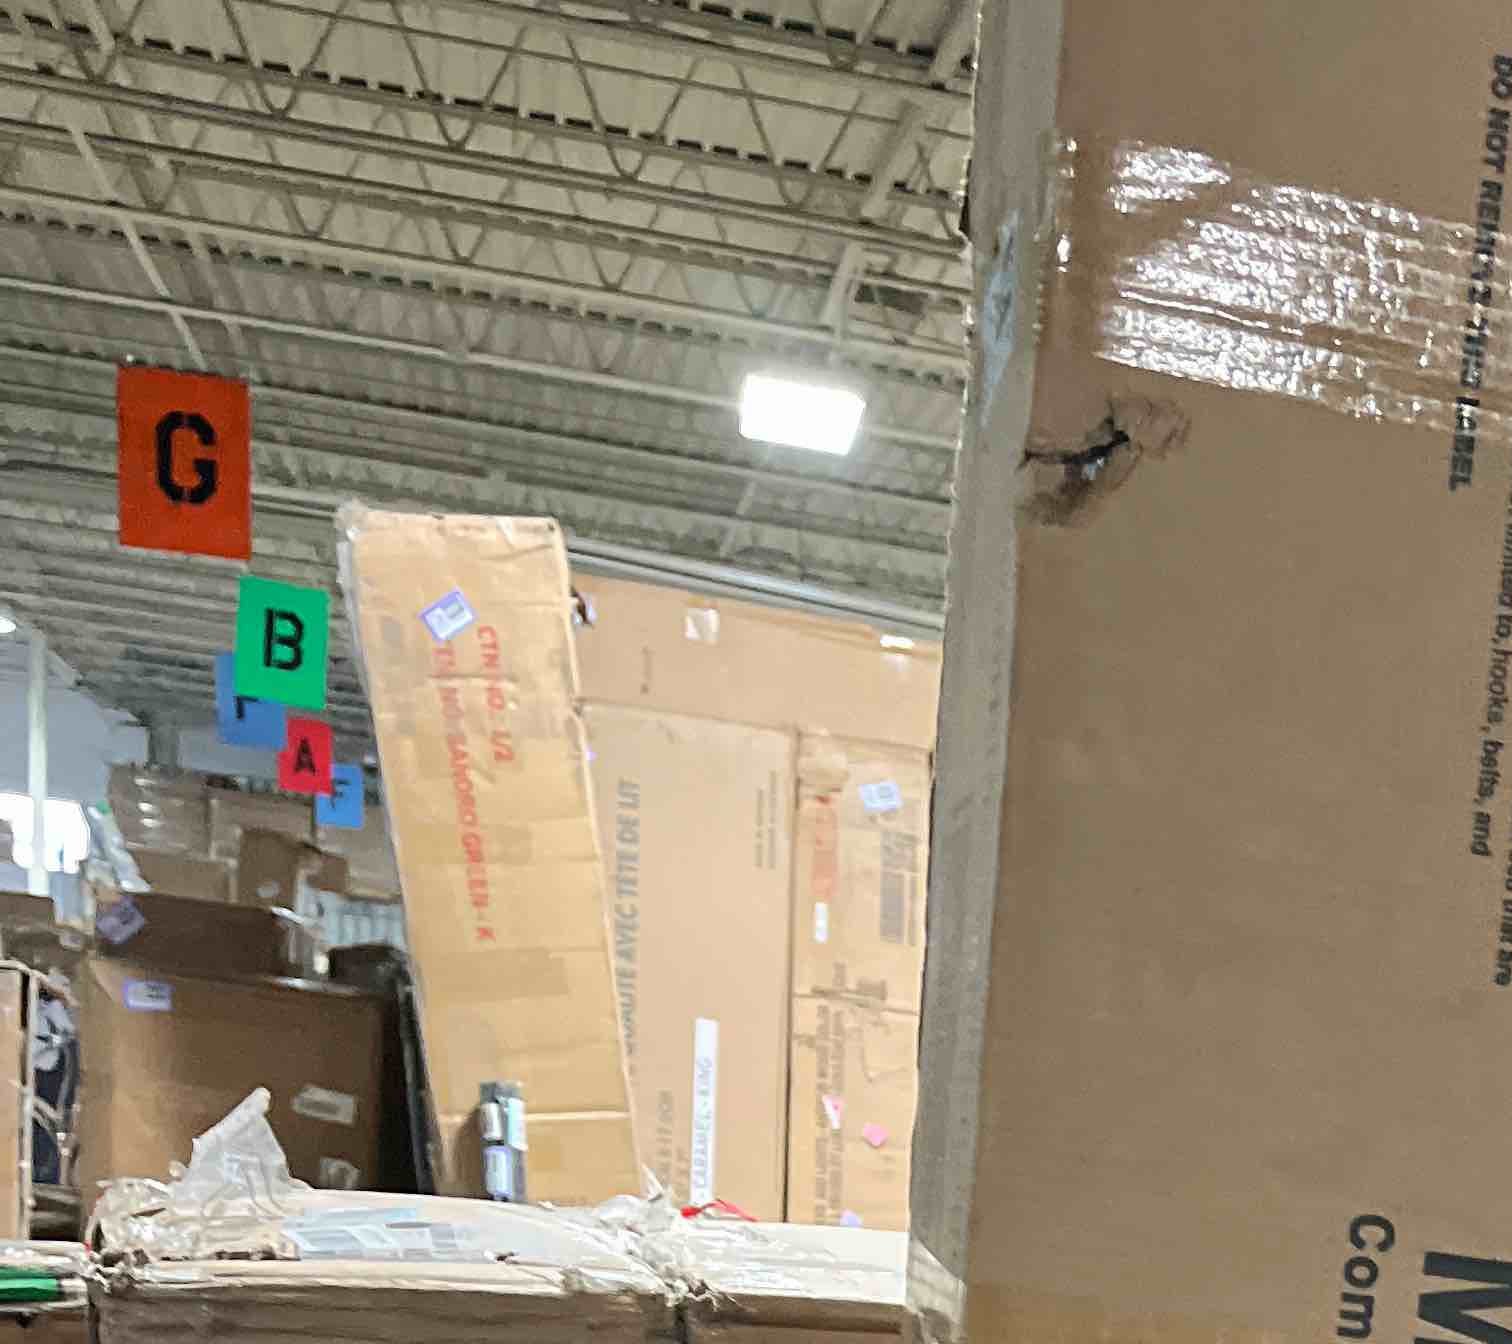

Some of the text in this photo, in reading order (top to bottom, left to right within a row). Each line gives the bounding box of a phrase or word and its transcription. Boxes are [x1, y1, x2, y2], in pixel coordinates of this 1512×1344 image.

[154, 410, 218, 506] G
[263, 607, 305, 671] B
[294, 737, 317, 775] A
